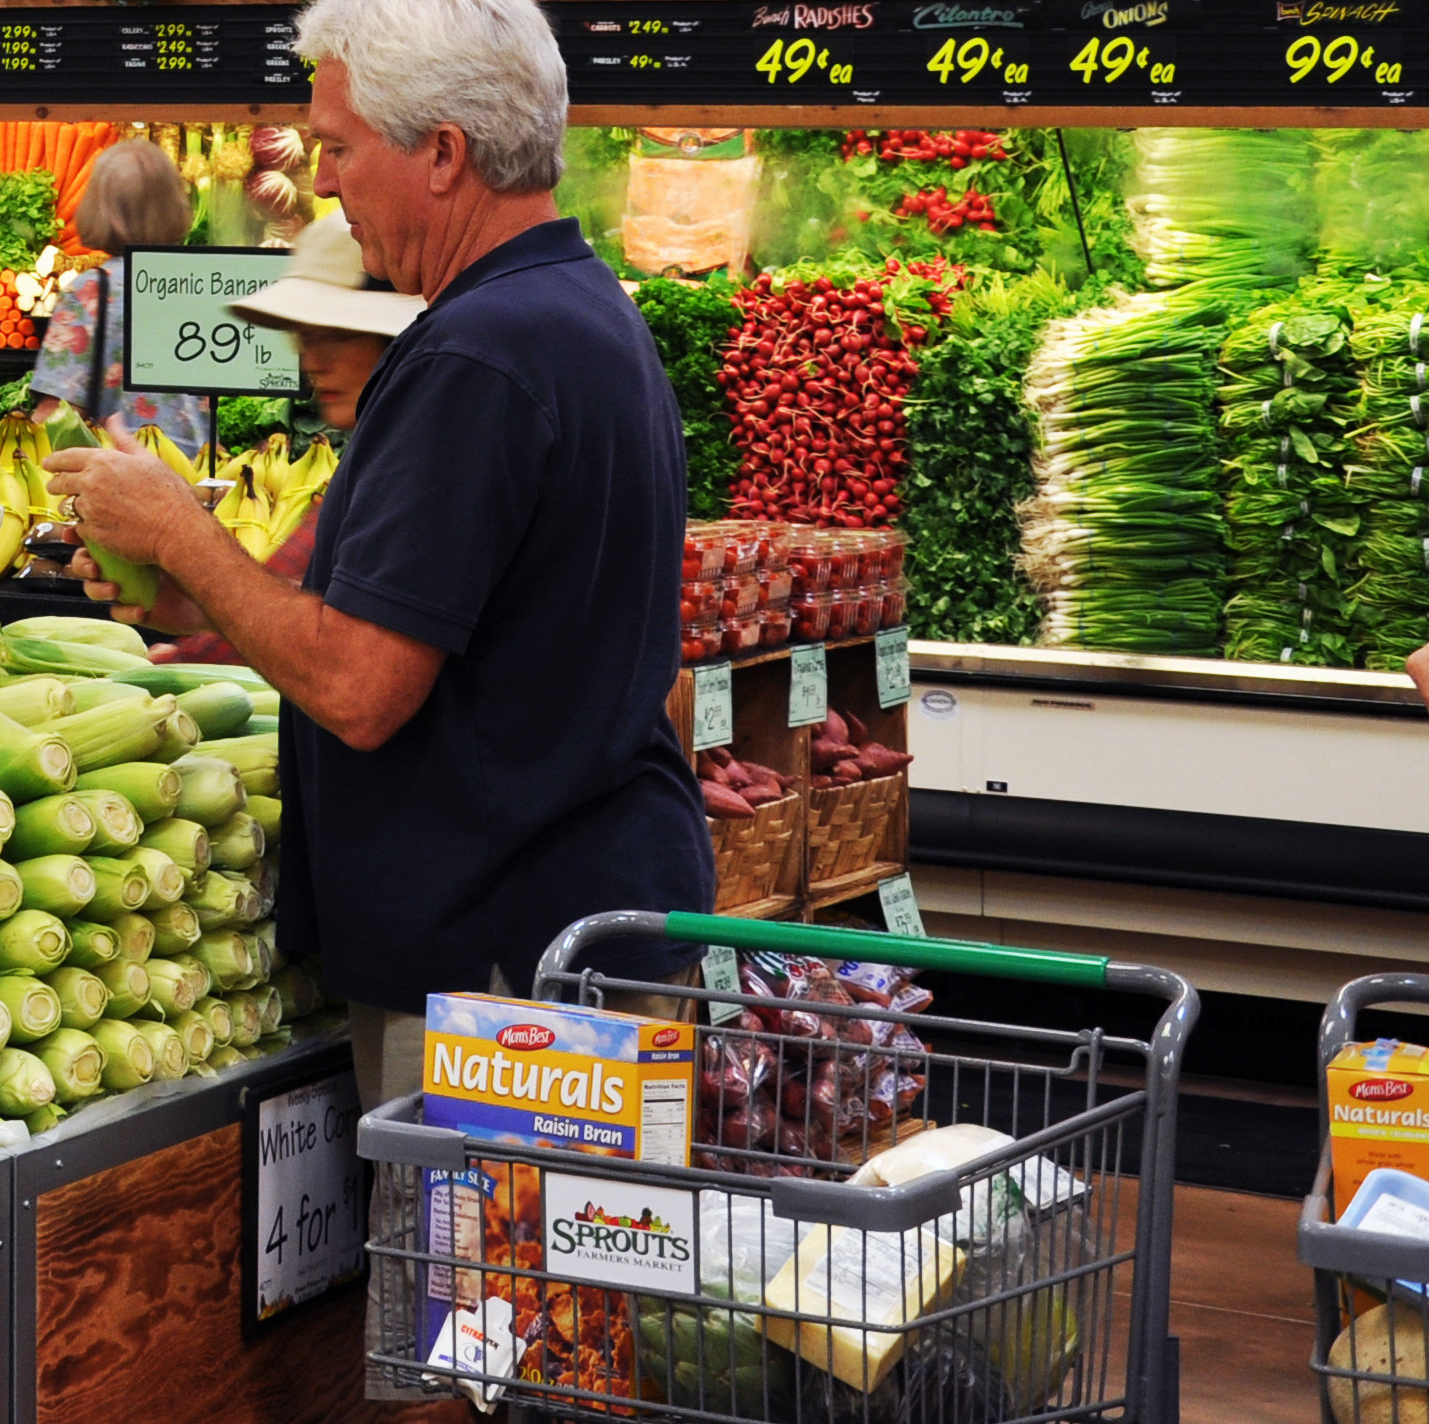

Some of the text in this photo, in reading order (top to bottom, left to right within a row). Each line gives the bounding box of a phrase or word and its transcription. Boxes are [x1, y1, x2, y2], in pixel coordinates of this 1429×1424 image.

[794, 4, 875, 29] RADISHES
[914, 3, 1021, 28] Cilantro
[1103, 1, 1168, 28] ONIONS
[1301, 1, 1400, 25] SPINACH
[756, 38, 853, 83] 49¢ ea
[927, 37, 1028, 83] 49¢ ea
[1070, 37, 1175, 83] 49¢ ea
[1286, 36, 1402, 83] 99¢ ea
[136, 269, 278, 301] Organic Banan
[174, 321, 272, 364] 89¢ lb
[501, 1027, 551, 1047] Mom's Best
[432, 1041, 625, 1114] Naturals
[1355, 1081, 1408, 1098] Mom's Best
[533, 1116, 623, 1146] Raisin Bran
[1333, 1104, 1429, 1129] Naturals
[260, 1120, 317, 1166] White
[265, 1194, 336, 1265] 4 for
[551, 1218, 690, 1262] SPROUTS
[577, 1249, 683, 1273] FARMERS MARKET
